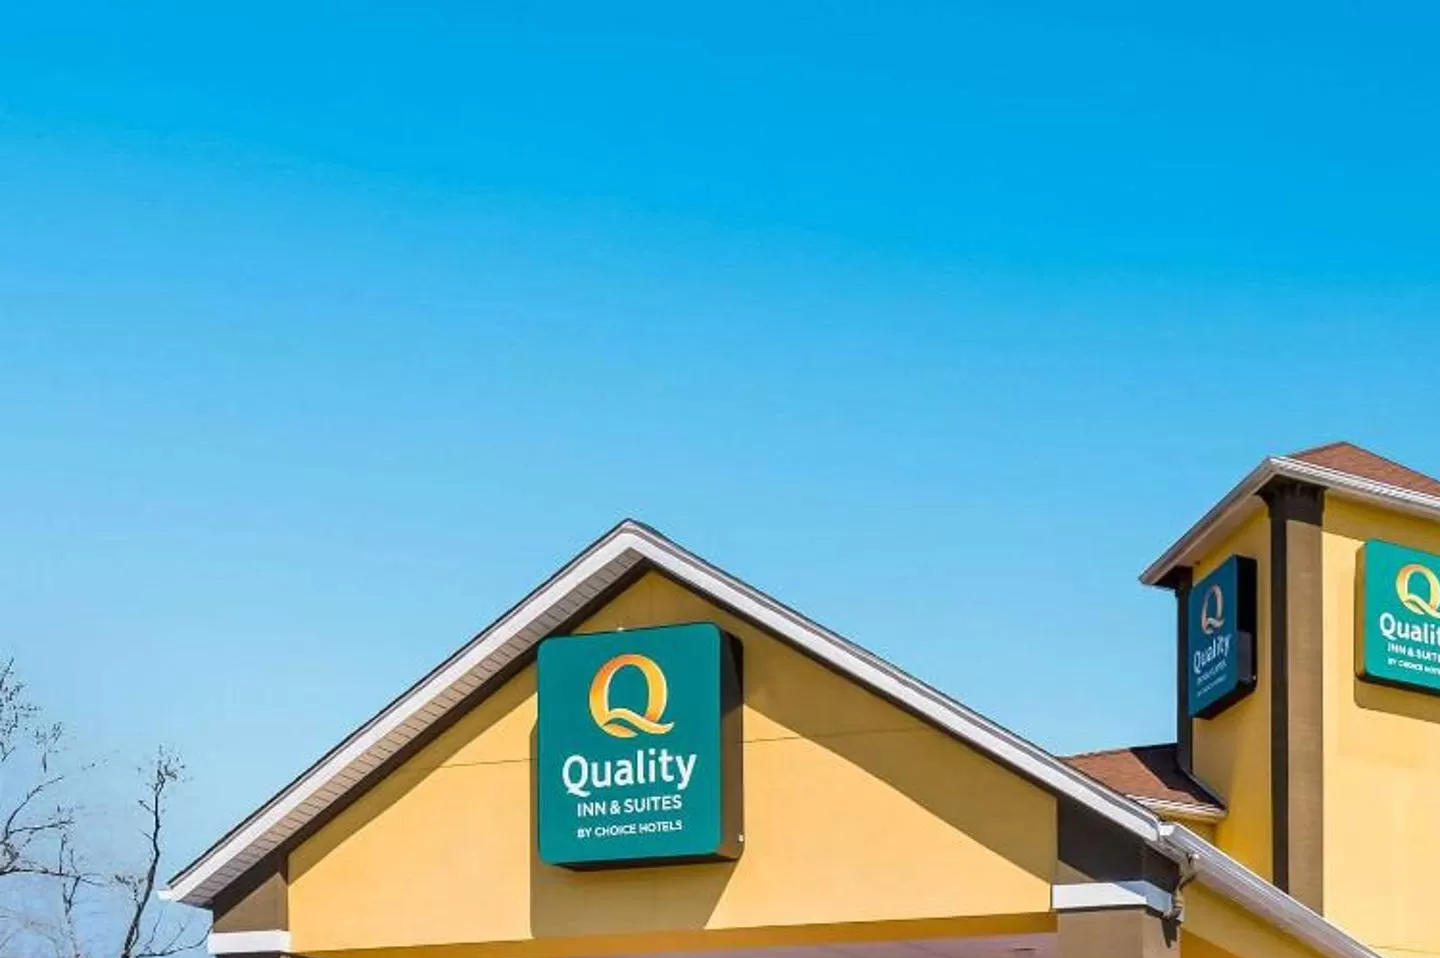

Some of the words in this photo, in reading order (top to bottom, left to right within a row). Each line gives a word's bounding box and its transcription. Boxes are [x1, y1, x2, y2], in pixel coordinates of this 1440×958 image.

[1201, 584, 1224, 634] Q
[1193, 634, 1231, 675] Quality
[589, 654, 674, 738] Q
[562, 748, 697, 797] Quality
[577, 801, 606, 817] INN
[610, 799, 621, 815] &
[624, 794, 682, 813] SUITES
[577, 827, 592, 838] BY
[594, 823, 636, 837] CHOICE
[639, 819, 682, 834] HOTELS
